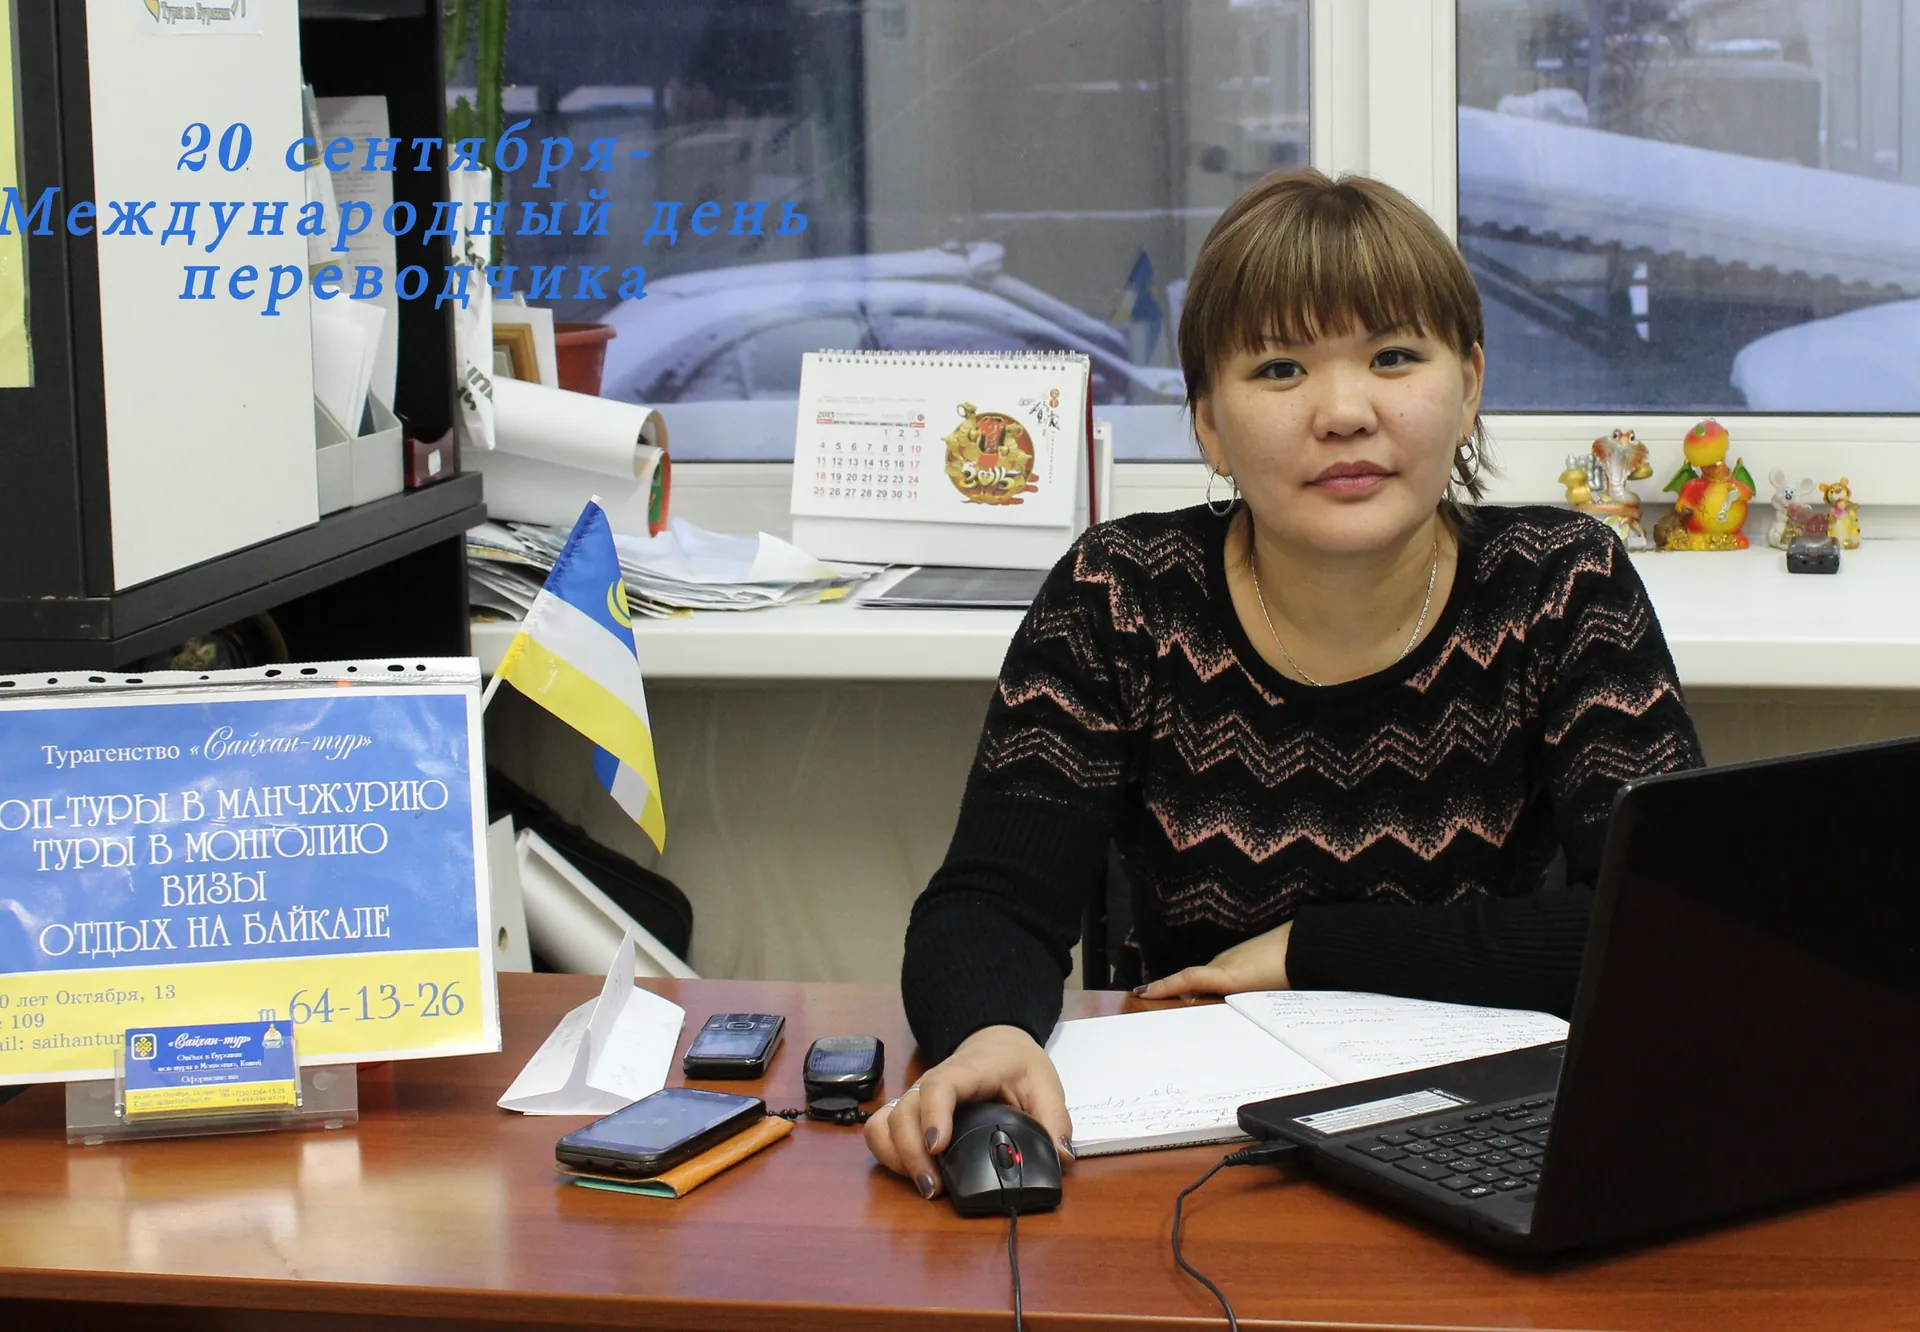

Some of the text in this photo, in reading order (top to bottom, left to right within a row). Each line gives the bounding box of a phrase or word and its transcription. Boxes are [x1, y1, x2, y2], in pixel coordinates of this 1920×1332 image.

[899, 429, 904, 437] 2
[914, 430, 919, 438] 3
[836, 442, 841, 450] 5
[852, 443, 857, 451] 6
[883, 444, 888, 452] 8
[898, 445, 903, 453] 9
[911, 445, 921, 453] 10
[833, 457, 842, 465] 12
[849, 458, 858, 466] 13
[864, 459, 874, 467] 14
[895, 460, 904, 468] 16
[832, 473, 841, 481] 19
[878, 475, 888, 483] 22
[892, 475, 903, 483] 23
[908, 476, 919, 484] 24
[861, 489, 871, 497] 28
[892, 490, 902, 498] 30
[41, 744, 180, 770] Турагенство
[181, 790, 206, 822] В
[217, 779, 449, 821] МАНЧЖУРИЮ
[33, 822, 388, 872] ТУРЫ В МОНГОЛИЮ
[161, 871, 267, 907] ВИЗЫ
[39, 905, 391, 960] ОТДЫХ НА БАЙКАЛЕ
[16, 995, 48, 1007] лет
[56, 988, 145, 1005] Октября,
[155, 985, 176, 1001] 13
[289, 981, 465, 1024] 64-13-26
[12, 1013, 45, 1029] 109
